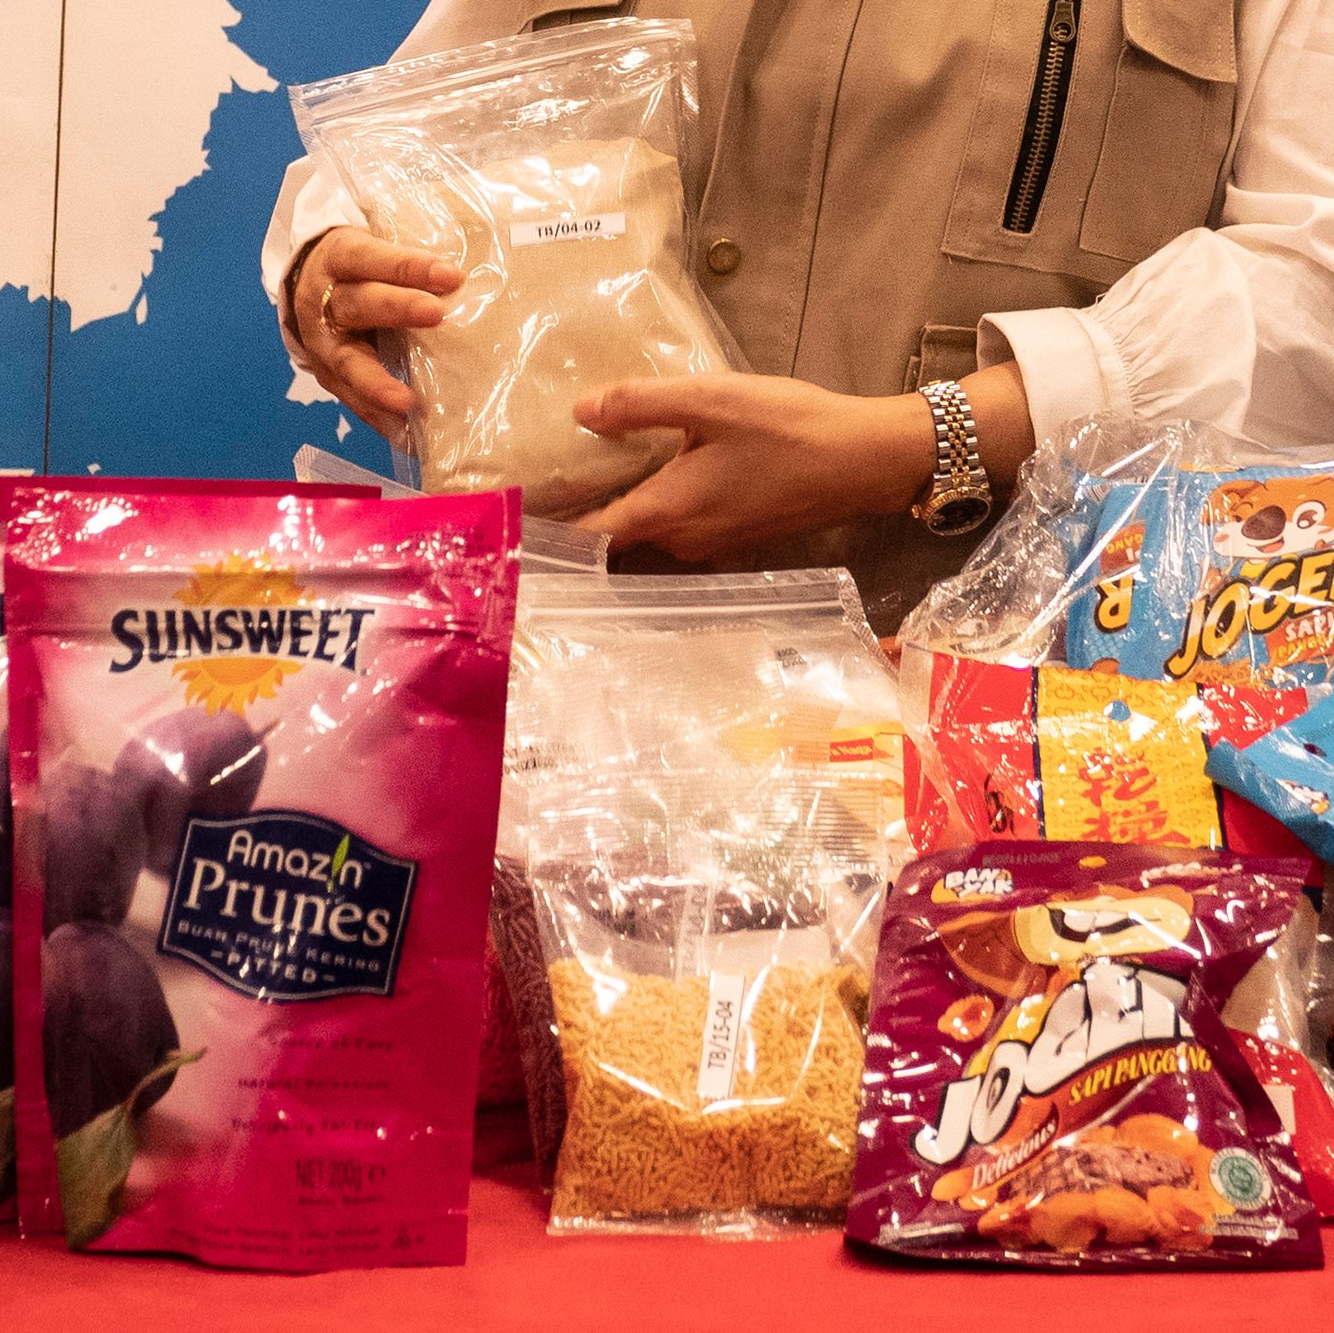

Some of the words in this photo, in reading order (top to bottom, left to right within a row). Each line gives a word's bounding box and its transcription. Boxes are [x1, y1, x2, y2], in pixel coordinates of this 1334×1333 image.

[109, 606, 375, 674] SUNSWEET
[182, 856, 391, 948] Prunes
[707, 1001, 734, 1069] TB/15-04
[1068, 1064, 1113, 1106] SAPI
